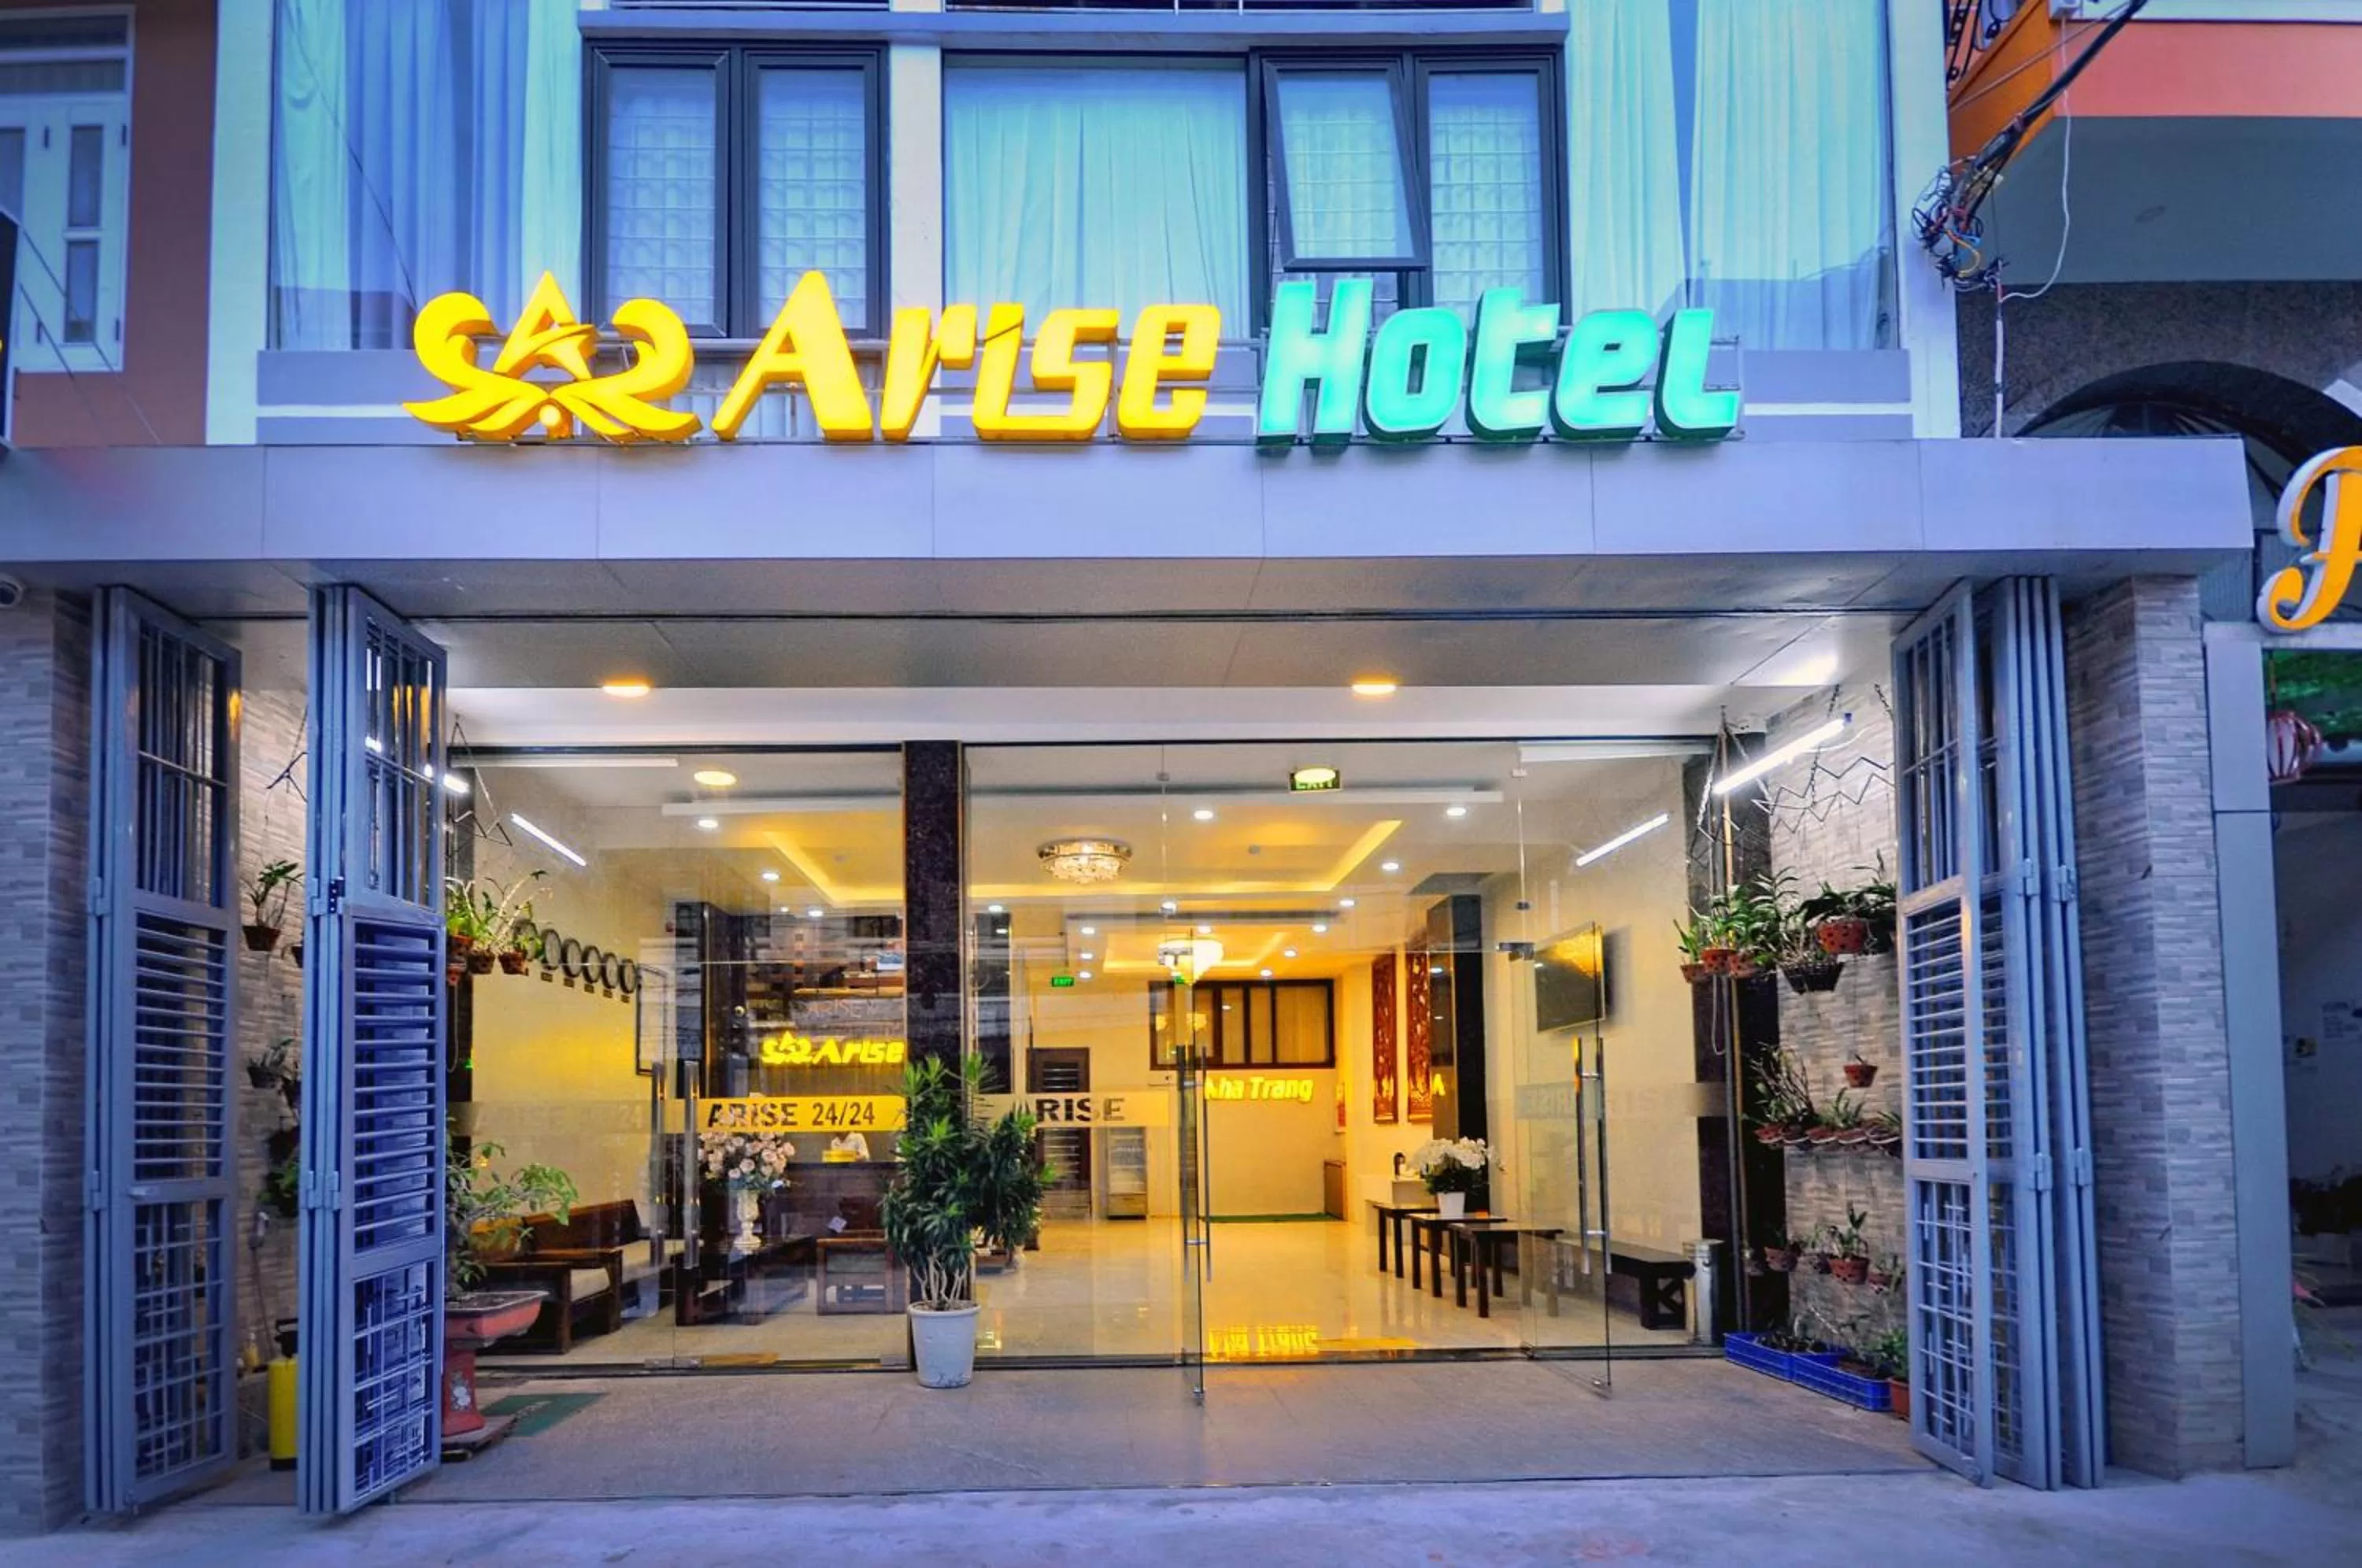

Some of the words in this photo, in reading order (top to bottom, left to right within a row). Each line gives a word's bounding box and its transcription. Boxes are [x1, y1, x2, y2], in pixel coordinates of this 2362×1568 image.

[711, 269, 1221, 442] Arise
[1258, 277, 1742, 441] Hotel
[812, 1037, 905, 1063] Arise
[1249, 1076, 1314, 1103] Trang
[708, 1103, 798, 1127] ARISE
[812, 1101, 876, 1126] 24/24
[1016, 1098, 1126, 1122] RISE
